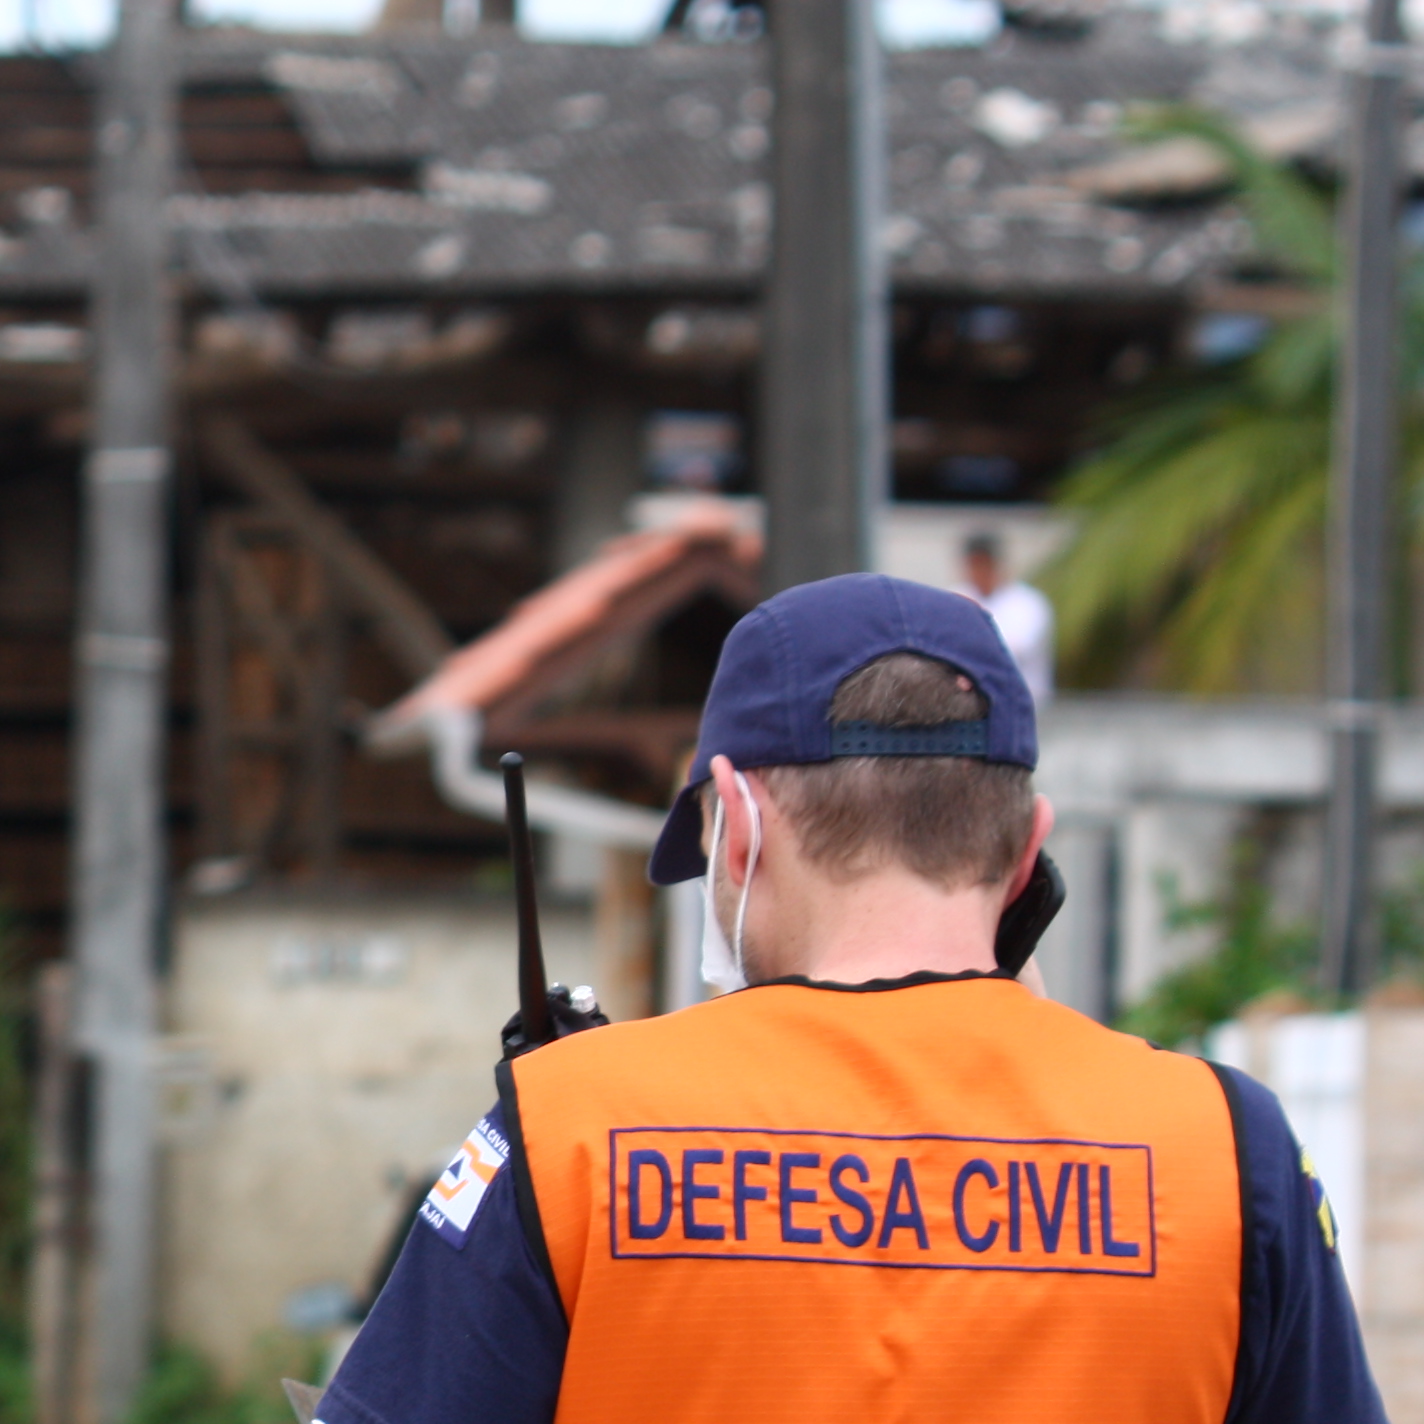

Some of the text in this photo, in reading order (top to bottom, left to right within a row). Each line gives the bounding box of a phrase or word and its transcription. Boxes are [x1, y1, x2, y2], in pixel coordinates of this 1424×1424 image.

[487, 1128, 512, 1158] CIVIL
[628, 1149, 1140, 1257] DEFESA CIVIL
